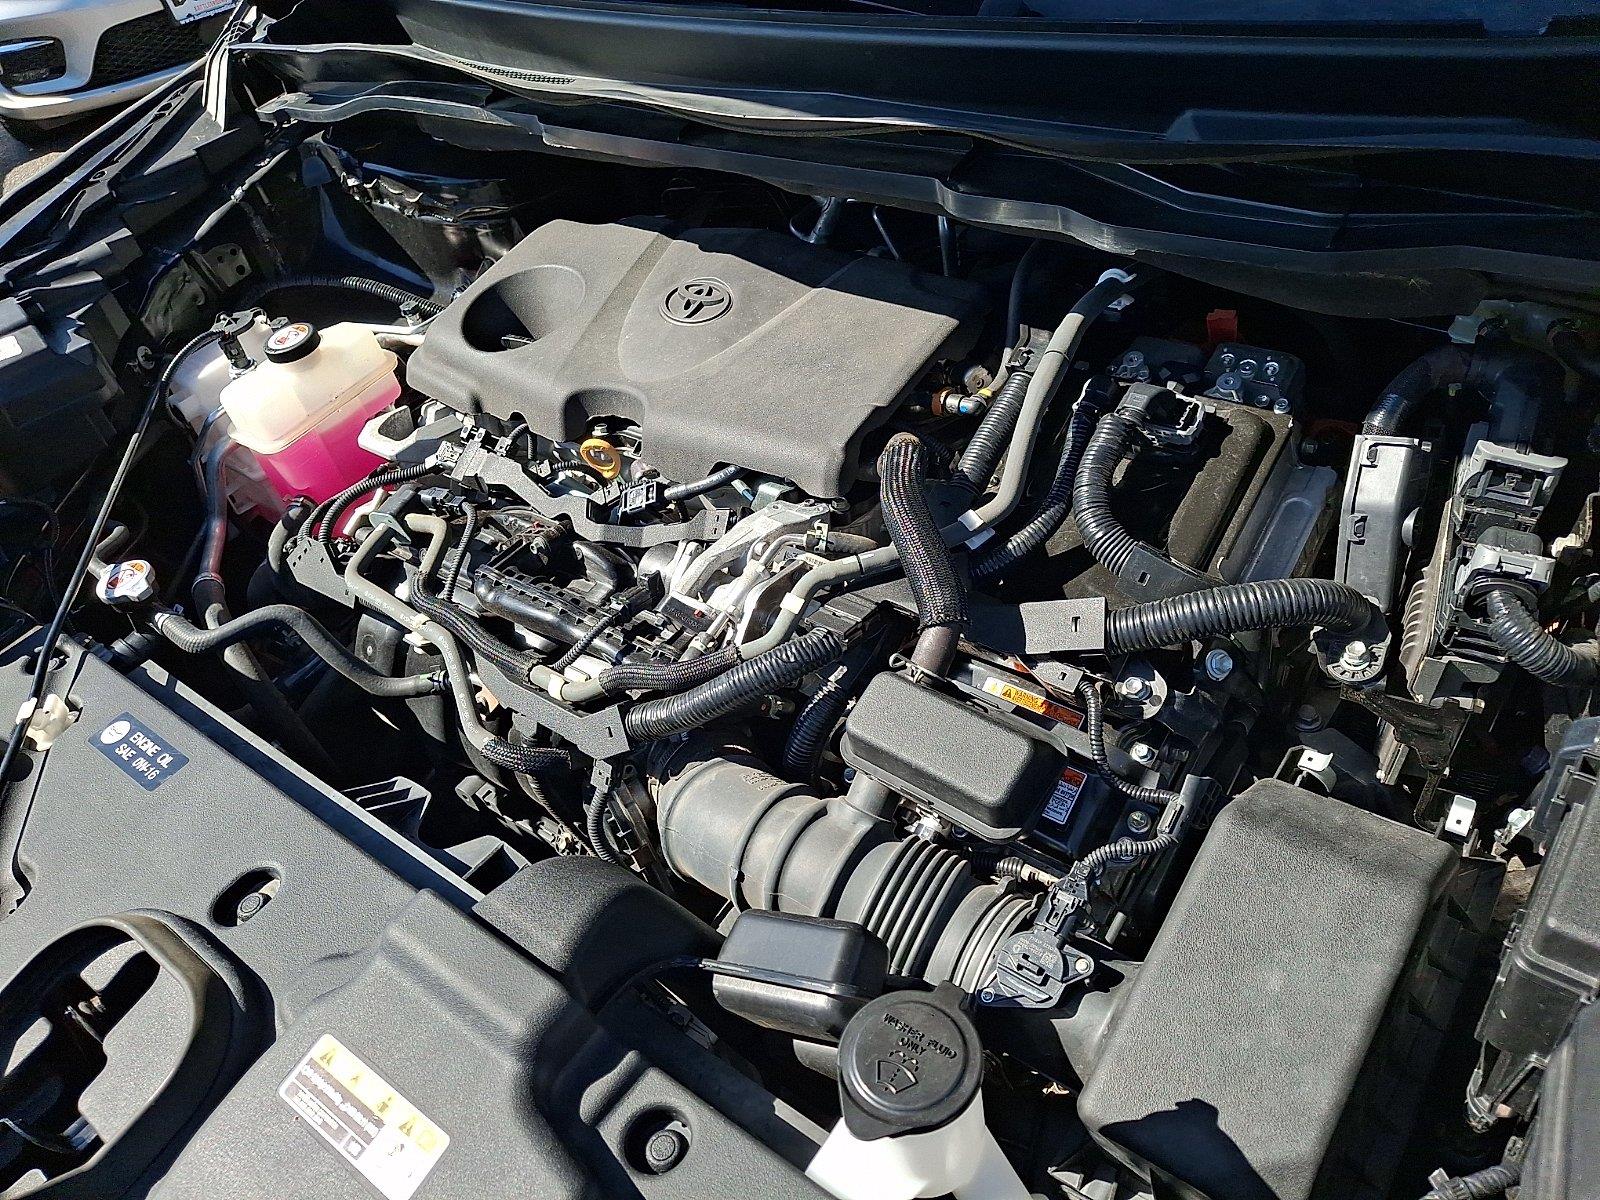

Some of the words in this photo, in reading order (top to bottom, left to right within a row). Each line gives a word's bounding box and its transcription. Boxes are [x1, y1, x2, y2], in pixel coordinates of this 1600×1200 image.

[114, 743, 137, 761] SAE
[132, 757, 160, 780] 0W-16
[129, 731, 162, 757] ENGINE
[156, 753, 174, 769] OIL
[883, 1013, 925, 1042] WASHER
[927, 1039, 958, 1060] FLUID
[899, 1037, 927, 1056] ONLY
